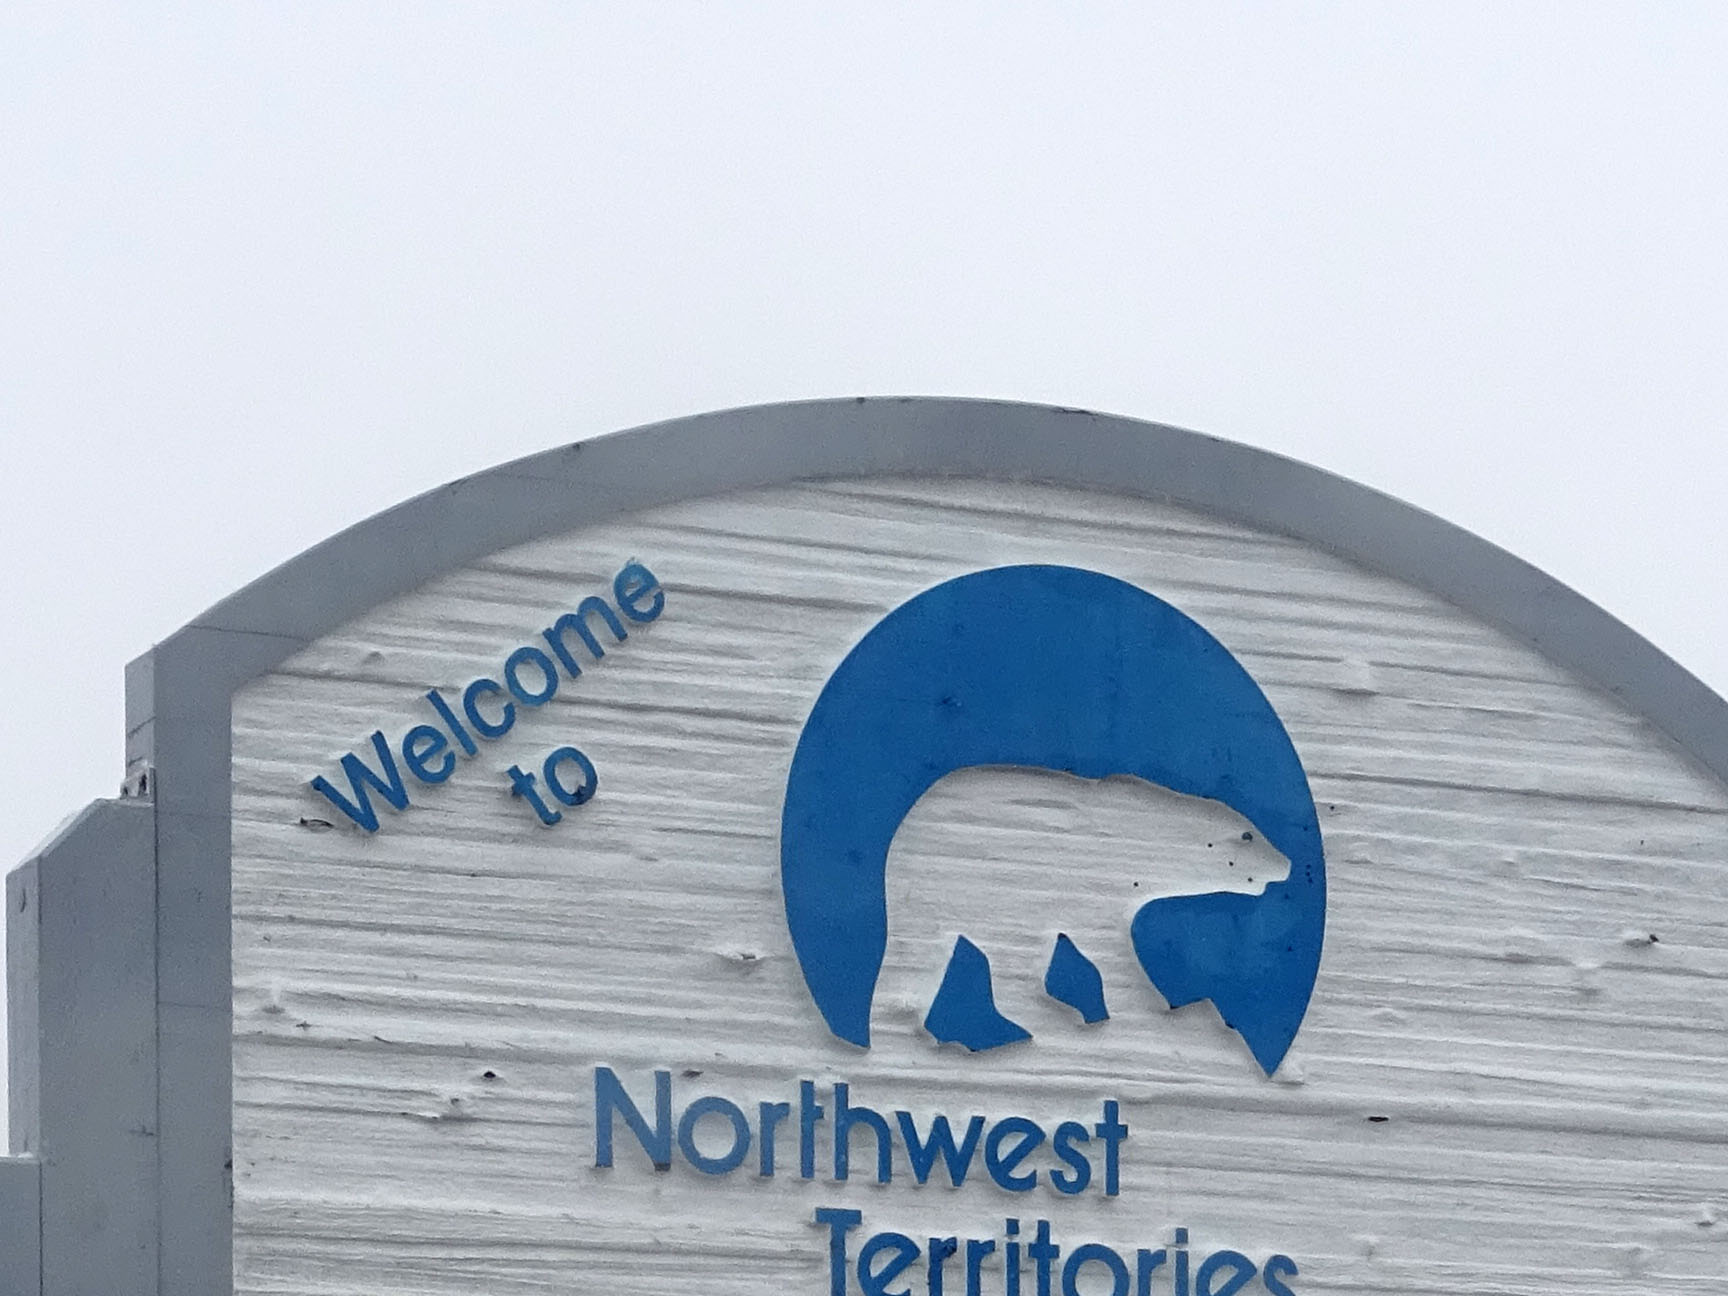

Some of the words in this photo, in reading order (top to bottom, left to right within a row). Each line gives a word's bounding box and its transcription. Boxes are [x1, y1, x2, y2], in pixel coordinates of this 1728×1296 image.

[310, 558, 665, 834] Welcome
[506, 747, 598, 826] to
[594, 1066, 1128, 1198] Northwest
